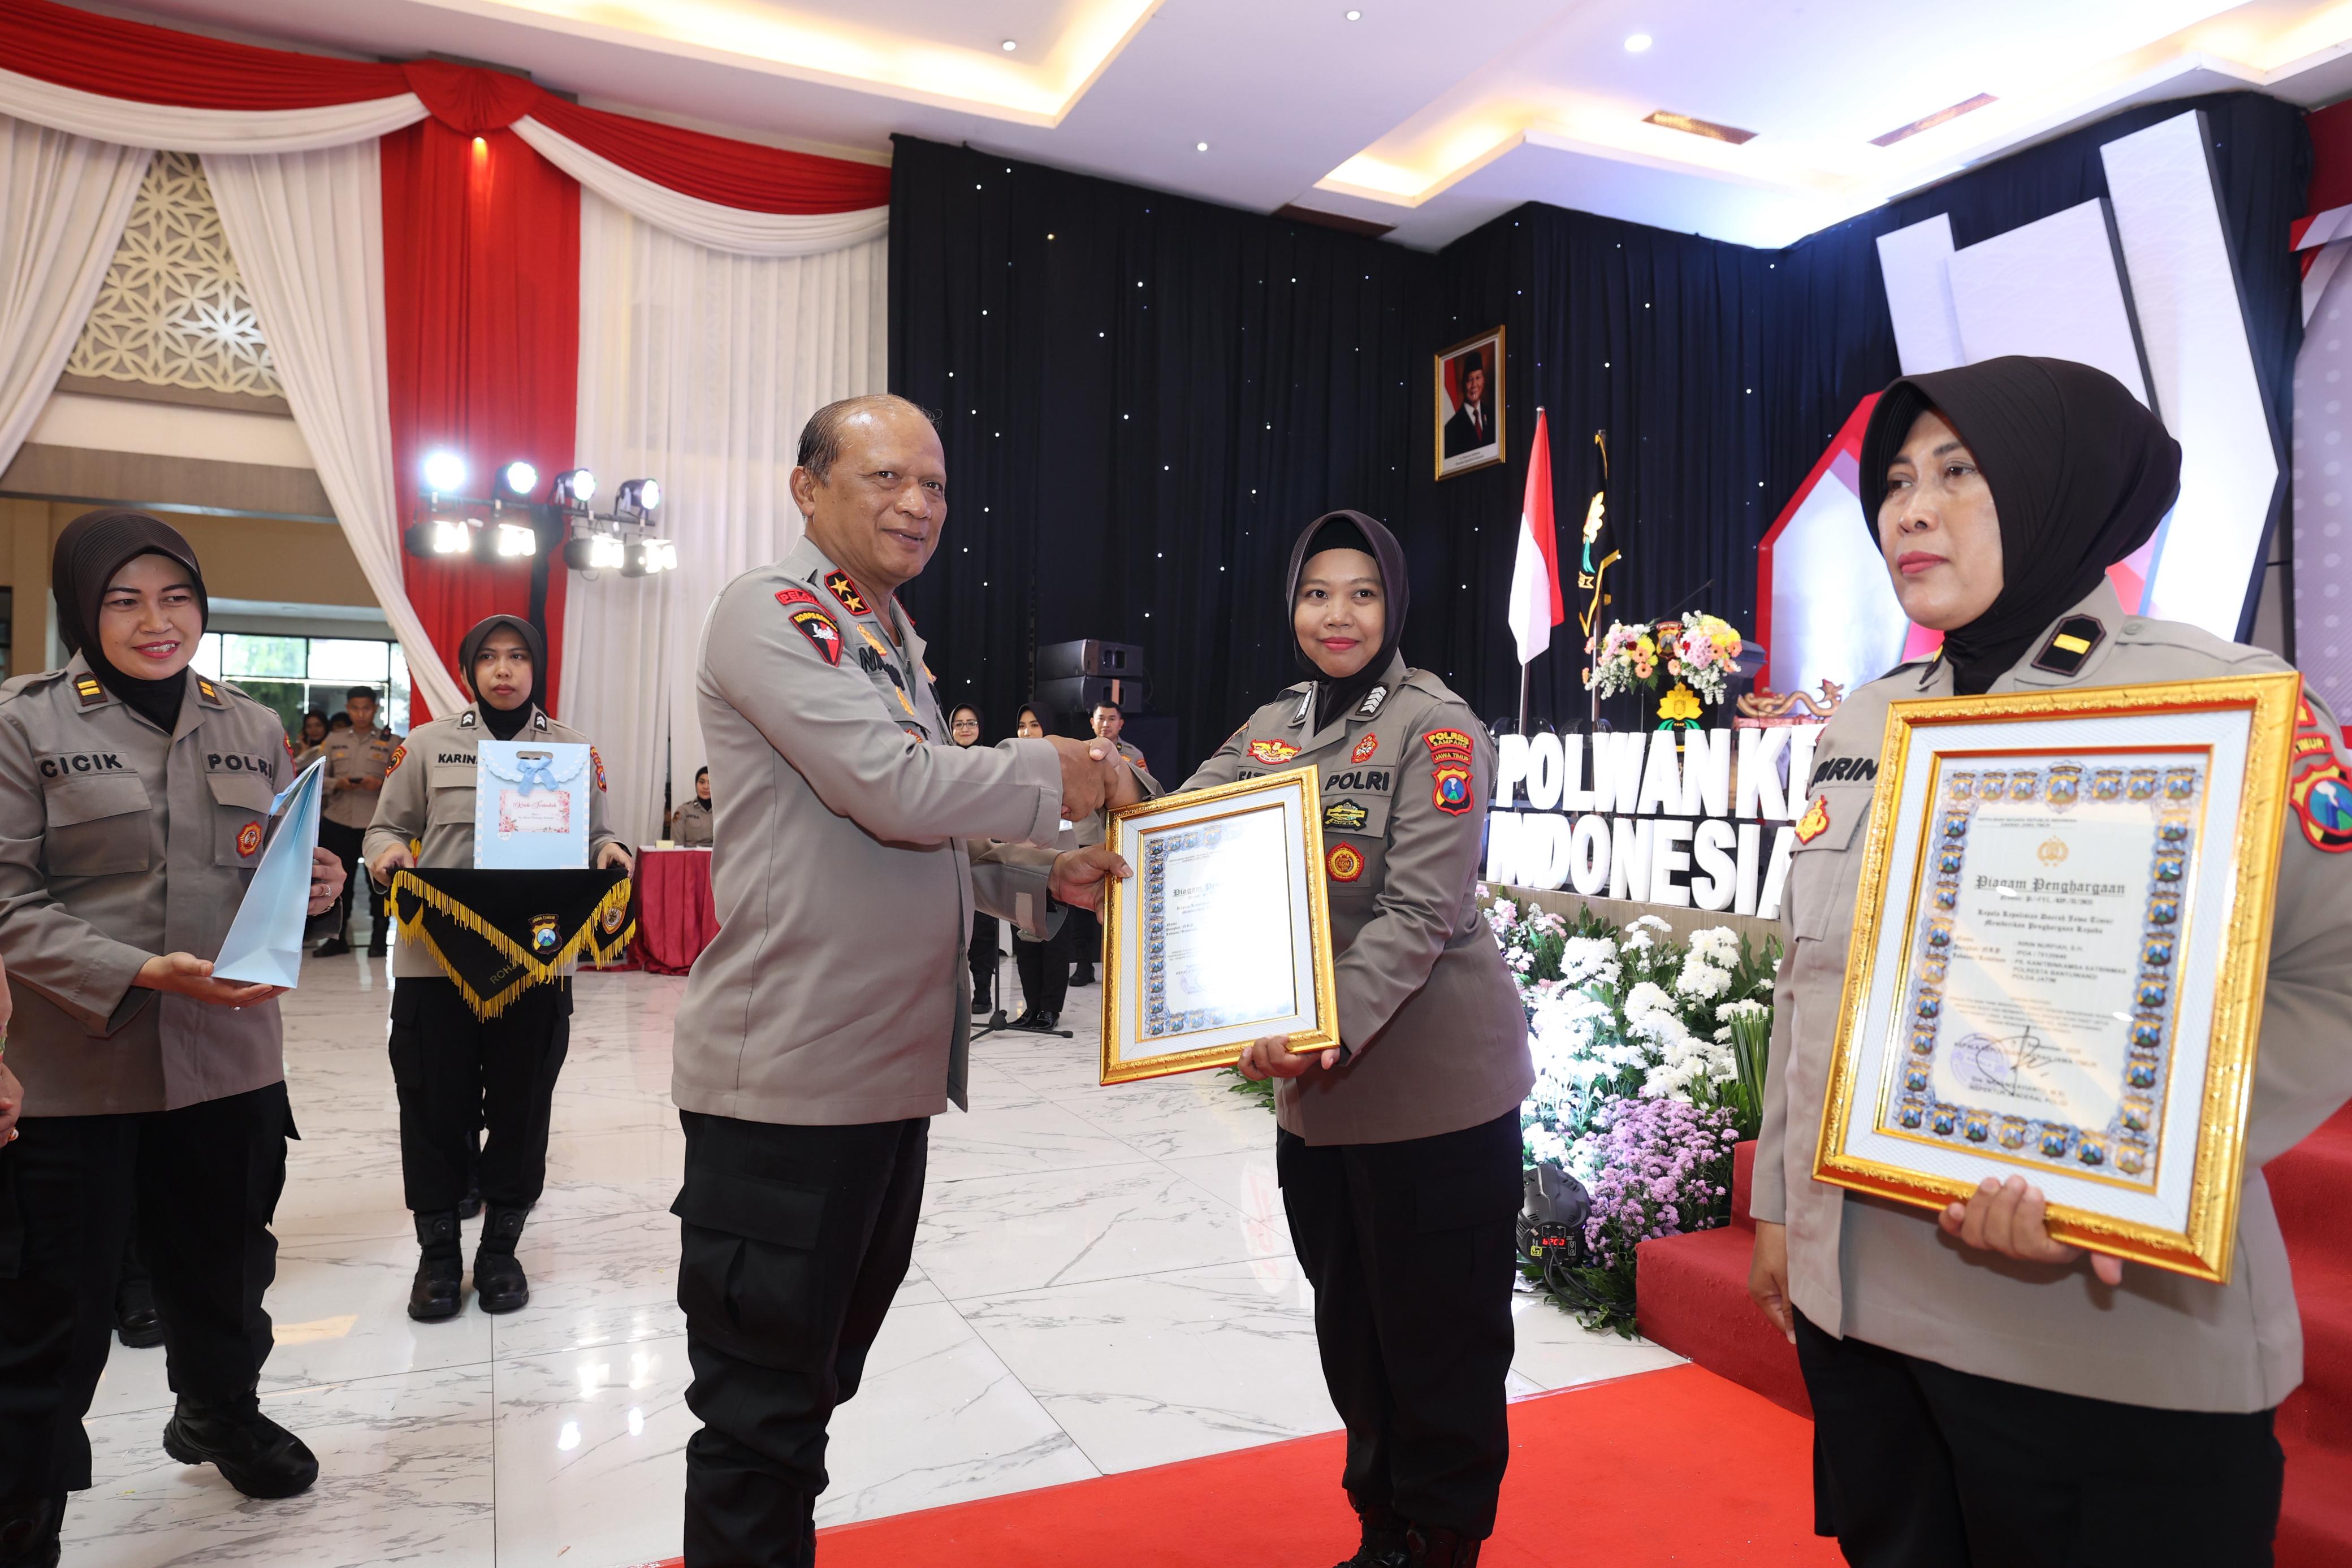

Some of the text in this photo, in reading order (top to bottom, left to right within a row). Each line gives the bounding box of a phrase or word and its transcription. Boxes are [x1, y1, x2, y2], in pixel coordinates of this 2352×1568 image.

[1428, 732, 1469, 745] POLRES
[1433, 739, 1467, 748] SAMPANG
[40, 752, 123, 779] CICIK
[207, 752, 273, 779] POLRI
[438, 753, 477, 764] KARIN
[1452, 753, 1470, 761] TIMUR
[1325, 771, 1389, 791] POLRI
[1495, 727, 1731, 817] POLWAN
[1486, 811, 1797, 920] INDONESIA
[1975, 875, 2125, 895] Piagam Penghargaan
